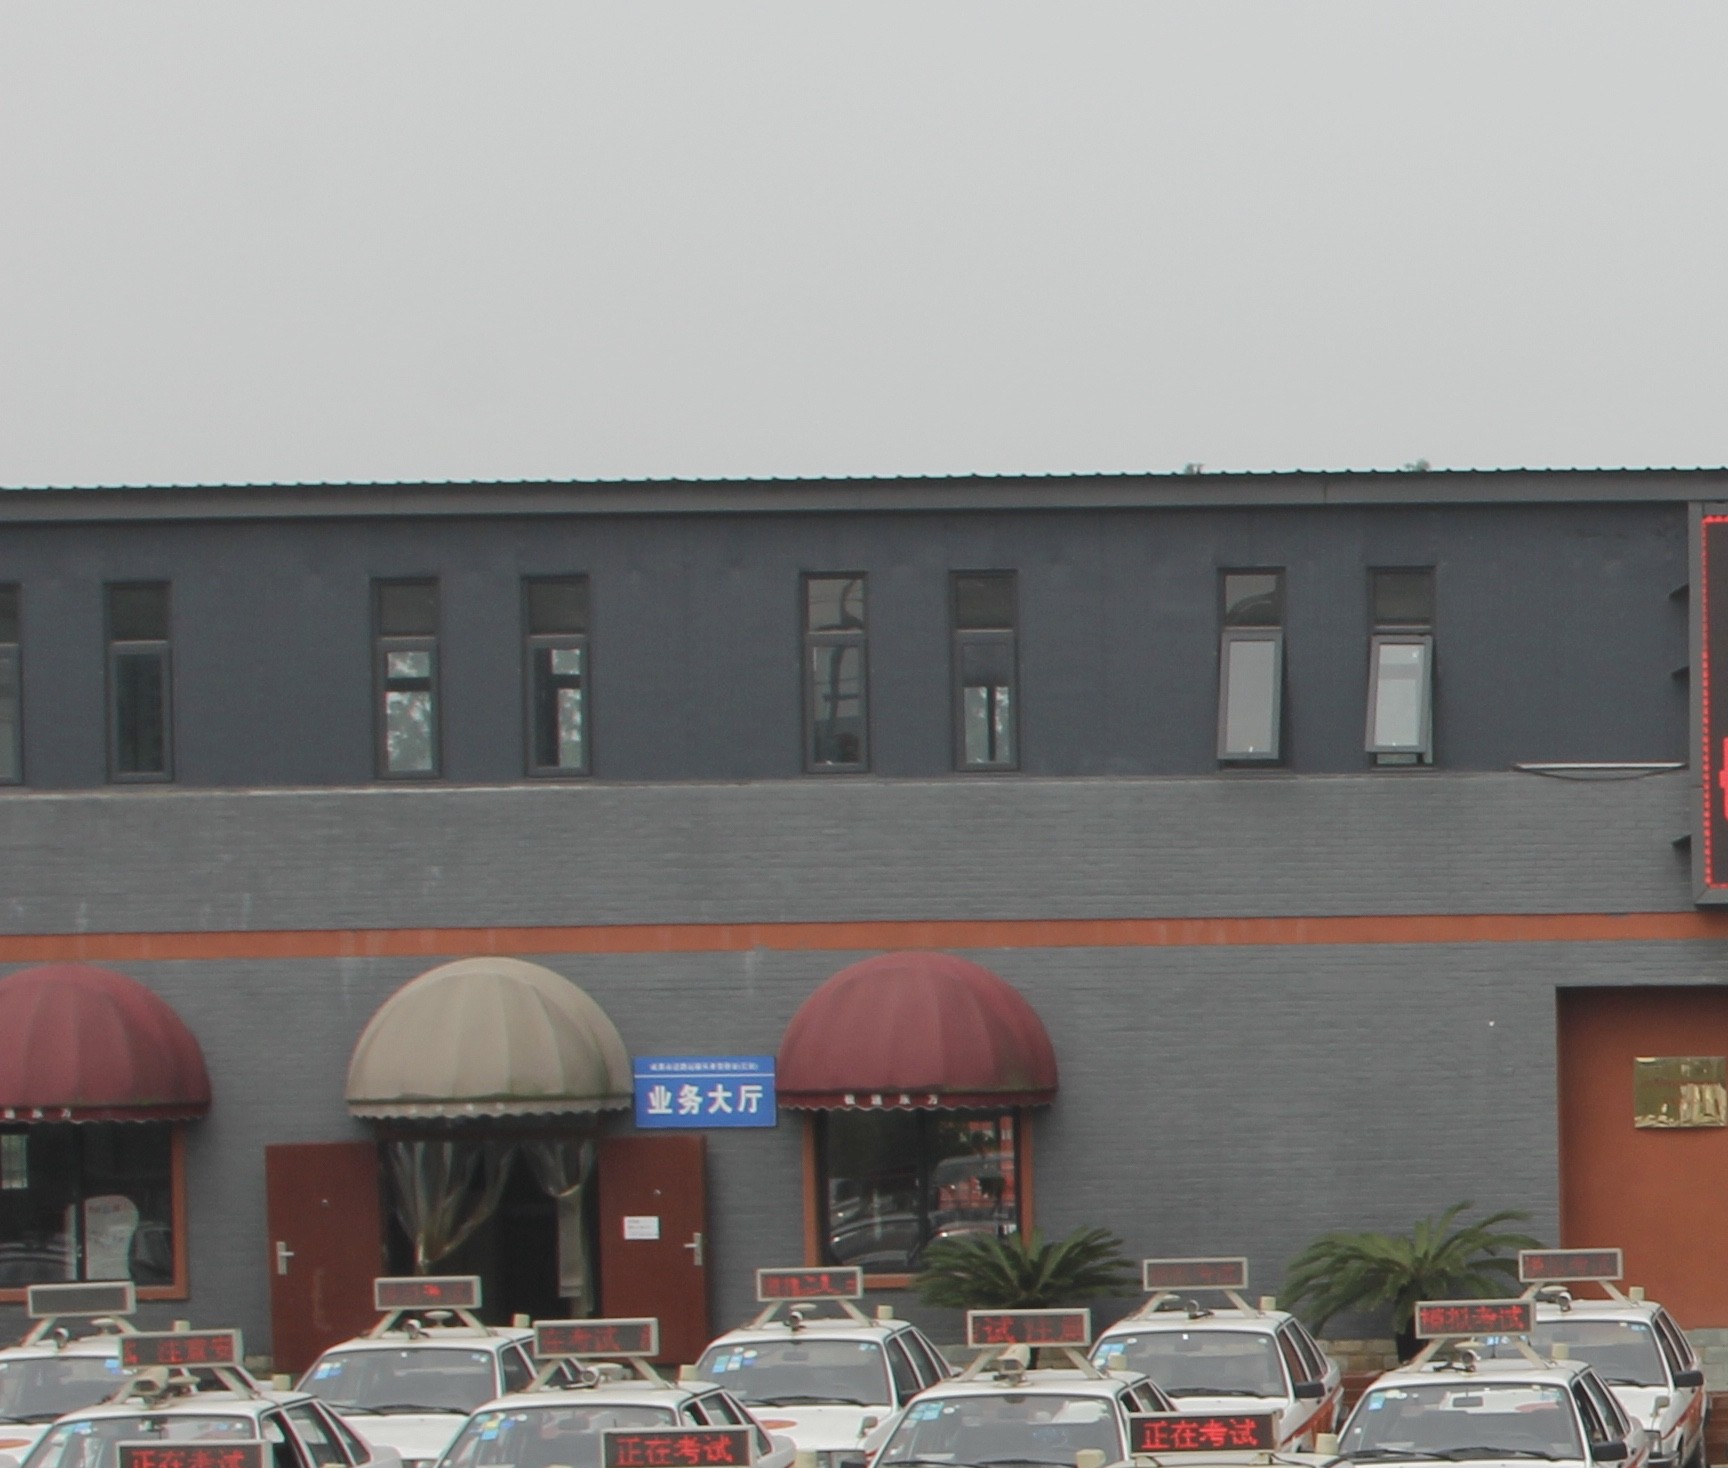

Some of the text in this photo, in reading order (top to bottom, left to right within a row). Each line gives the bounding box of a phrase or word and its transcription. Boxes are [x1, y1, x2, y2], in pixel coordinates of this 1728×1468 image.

[648, 1084, 763, 1114] 业务大厅
[1141, 1419, 1257, 1450] 正在考试
[617, 1434, 734, 1467] 正在考试
